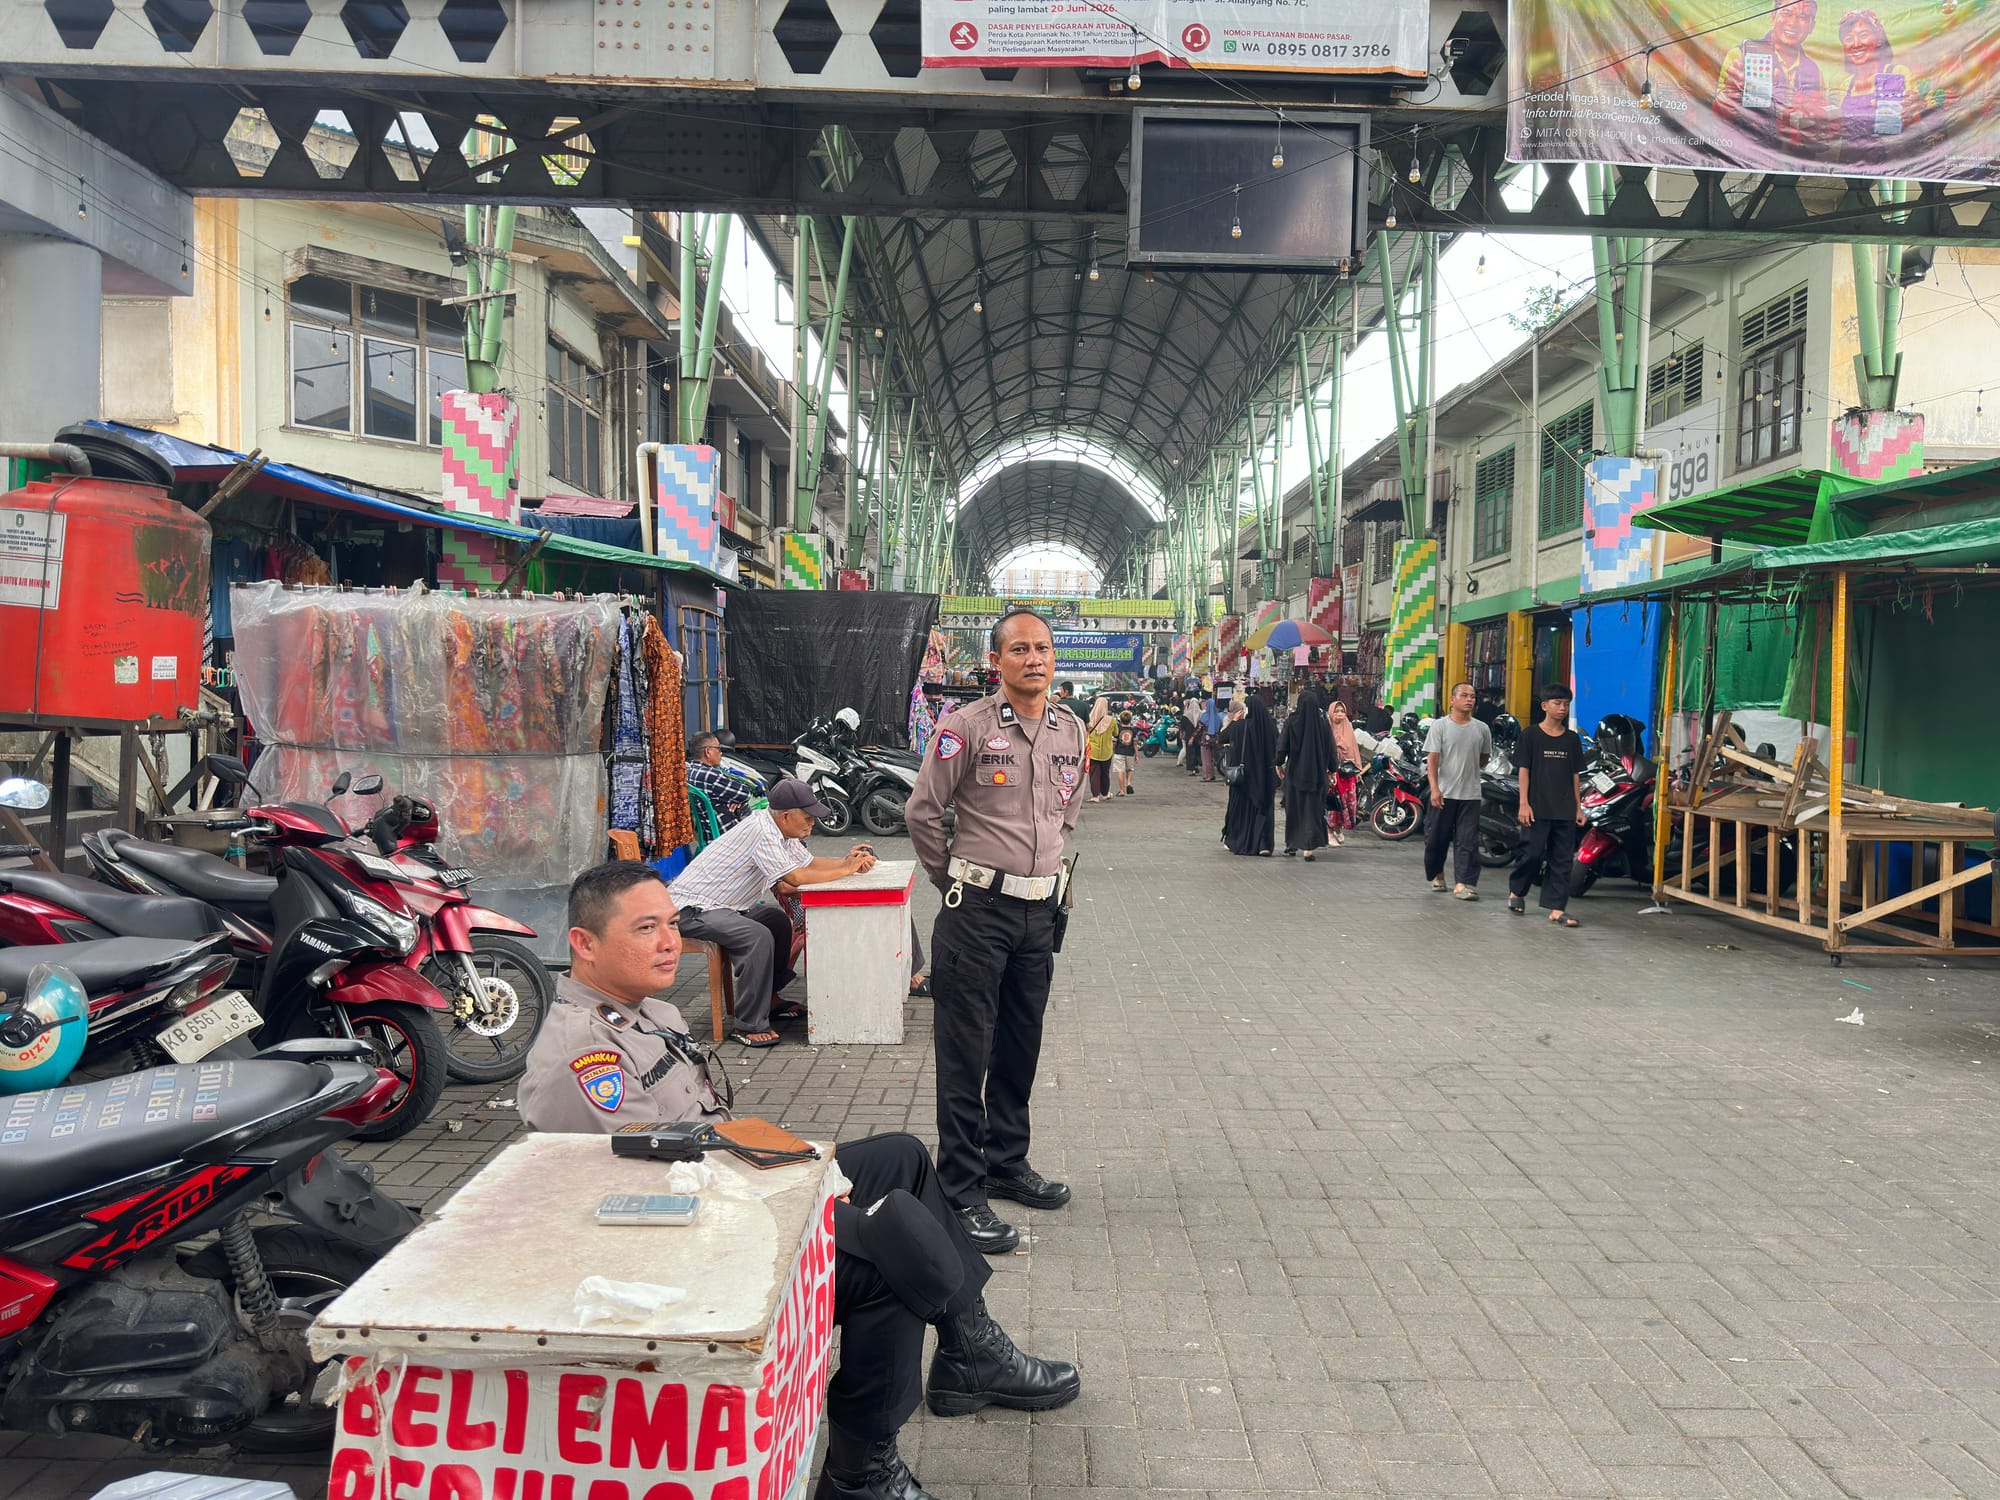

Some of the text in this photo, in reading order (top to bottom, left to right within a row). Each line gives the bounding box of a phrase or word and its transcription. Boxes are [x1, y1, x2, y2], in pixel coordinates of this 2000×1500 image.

[988, 5, 1015, 14] paling
[1018, 4, 1048, 13] lambat
[1051, 4, 1064, 13] 20
[1066, 4, 1088, 12] Juni
[1016, 22, 1094, 30] PENYELENGGARAAN
[1224, 29, 1352, 41] NOMOR PELAYANAN BIDANG PASAR:
[1242, 42, 1390, 58] WA 0895 0817 3786
[1524, 92, 1688, 110] Periode hingga 31 Deseer 2026
[1536, 128, 1560, 138] MITA
[1652, 135, 1686, 145] mandiri
[1706, 137, 1734, 148] 14000
[1673, 436, 1709, 458] TNUN
[1071, 637, 1107, 645] DATANG
[1064, 649, 1133, 660] RASULULLAH
[981, 754, 1015, 765] ERIK
[300, 932, 331, 954] YAMAHA
[162, 1028, 188, 1050] KB
[187, 1009, 222, 1034] 6561
[228, 995, 248, 1012] HE
[97, 1075, 135, 1129] BRIDE
[144, 1066, 178, 1123] BRIDE
[192, 1063, 224, 1122] BRIDE
[342, 1355, 529, 1454] BELI
[558, 1360, 774, 1472] EMAS
